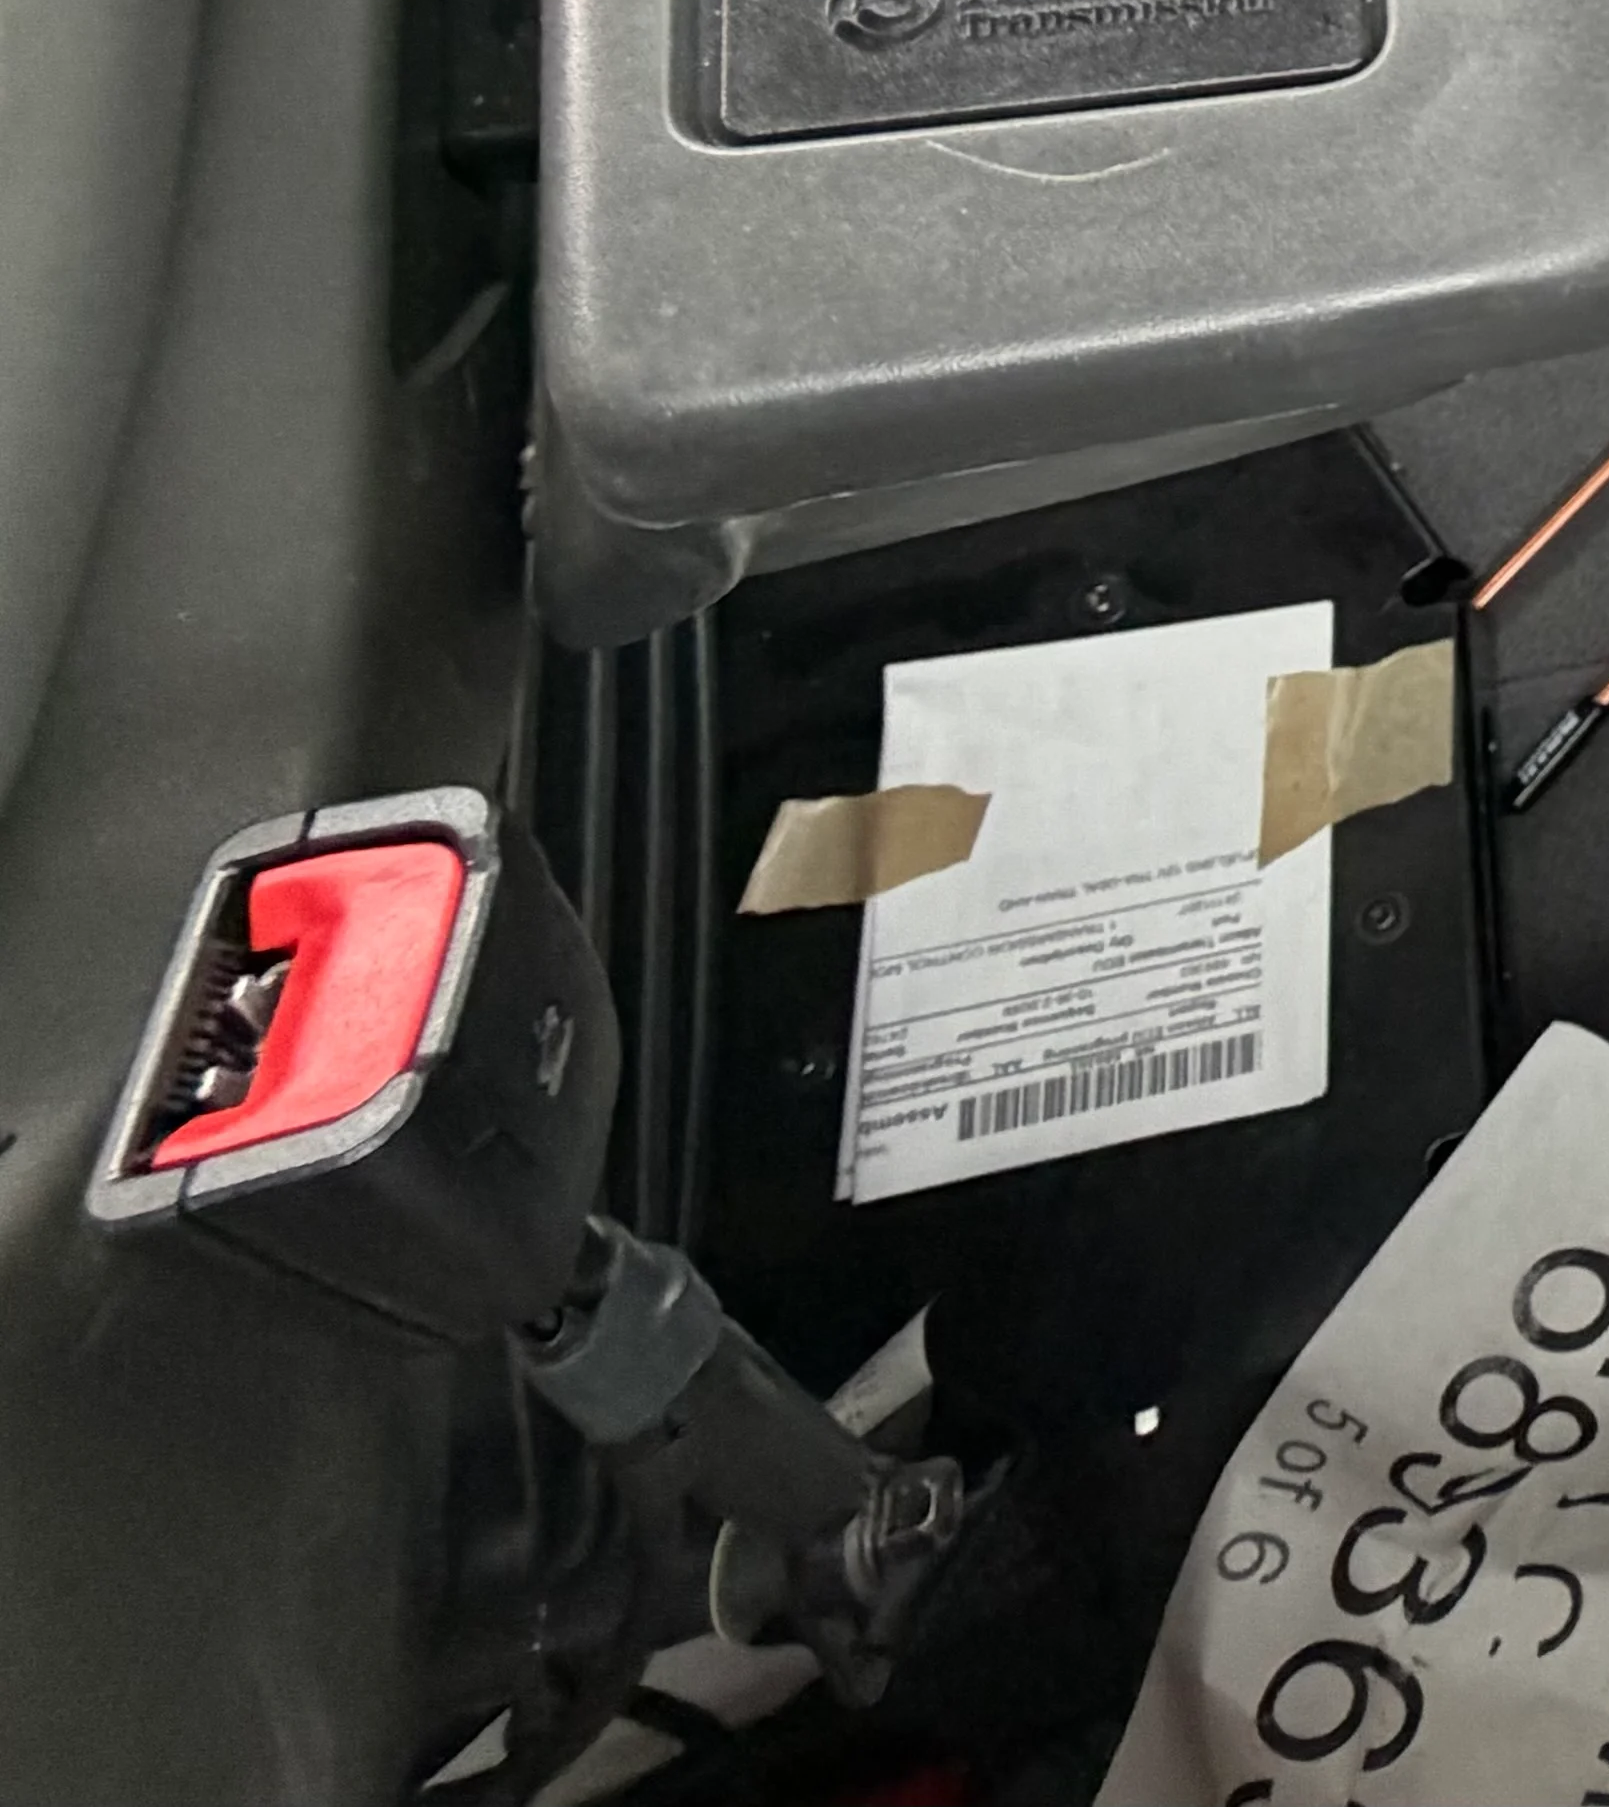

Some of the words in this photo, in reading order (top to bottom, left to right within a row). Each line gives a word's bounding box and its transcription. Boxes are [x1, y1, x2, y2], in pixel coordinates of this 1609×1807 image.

[1307, 1399, 1369, 1446] 5
[1258, 1440, 1323, 1512] of
[1216, 1532, 1290, 1586] 6
